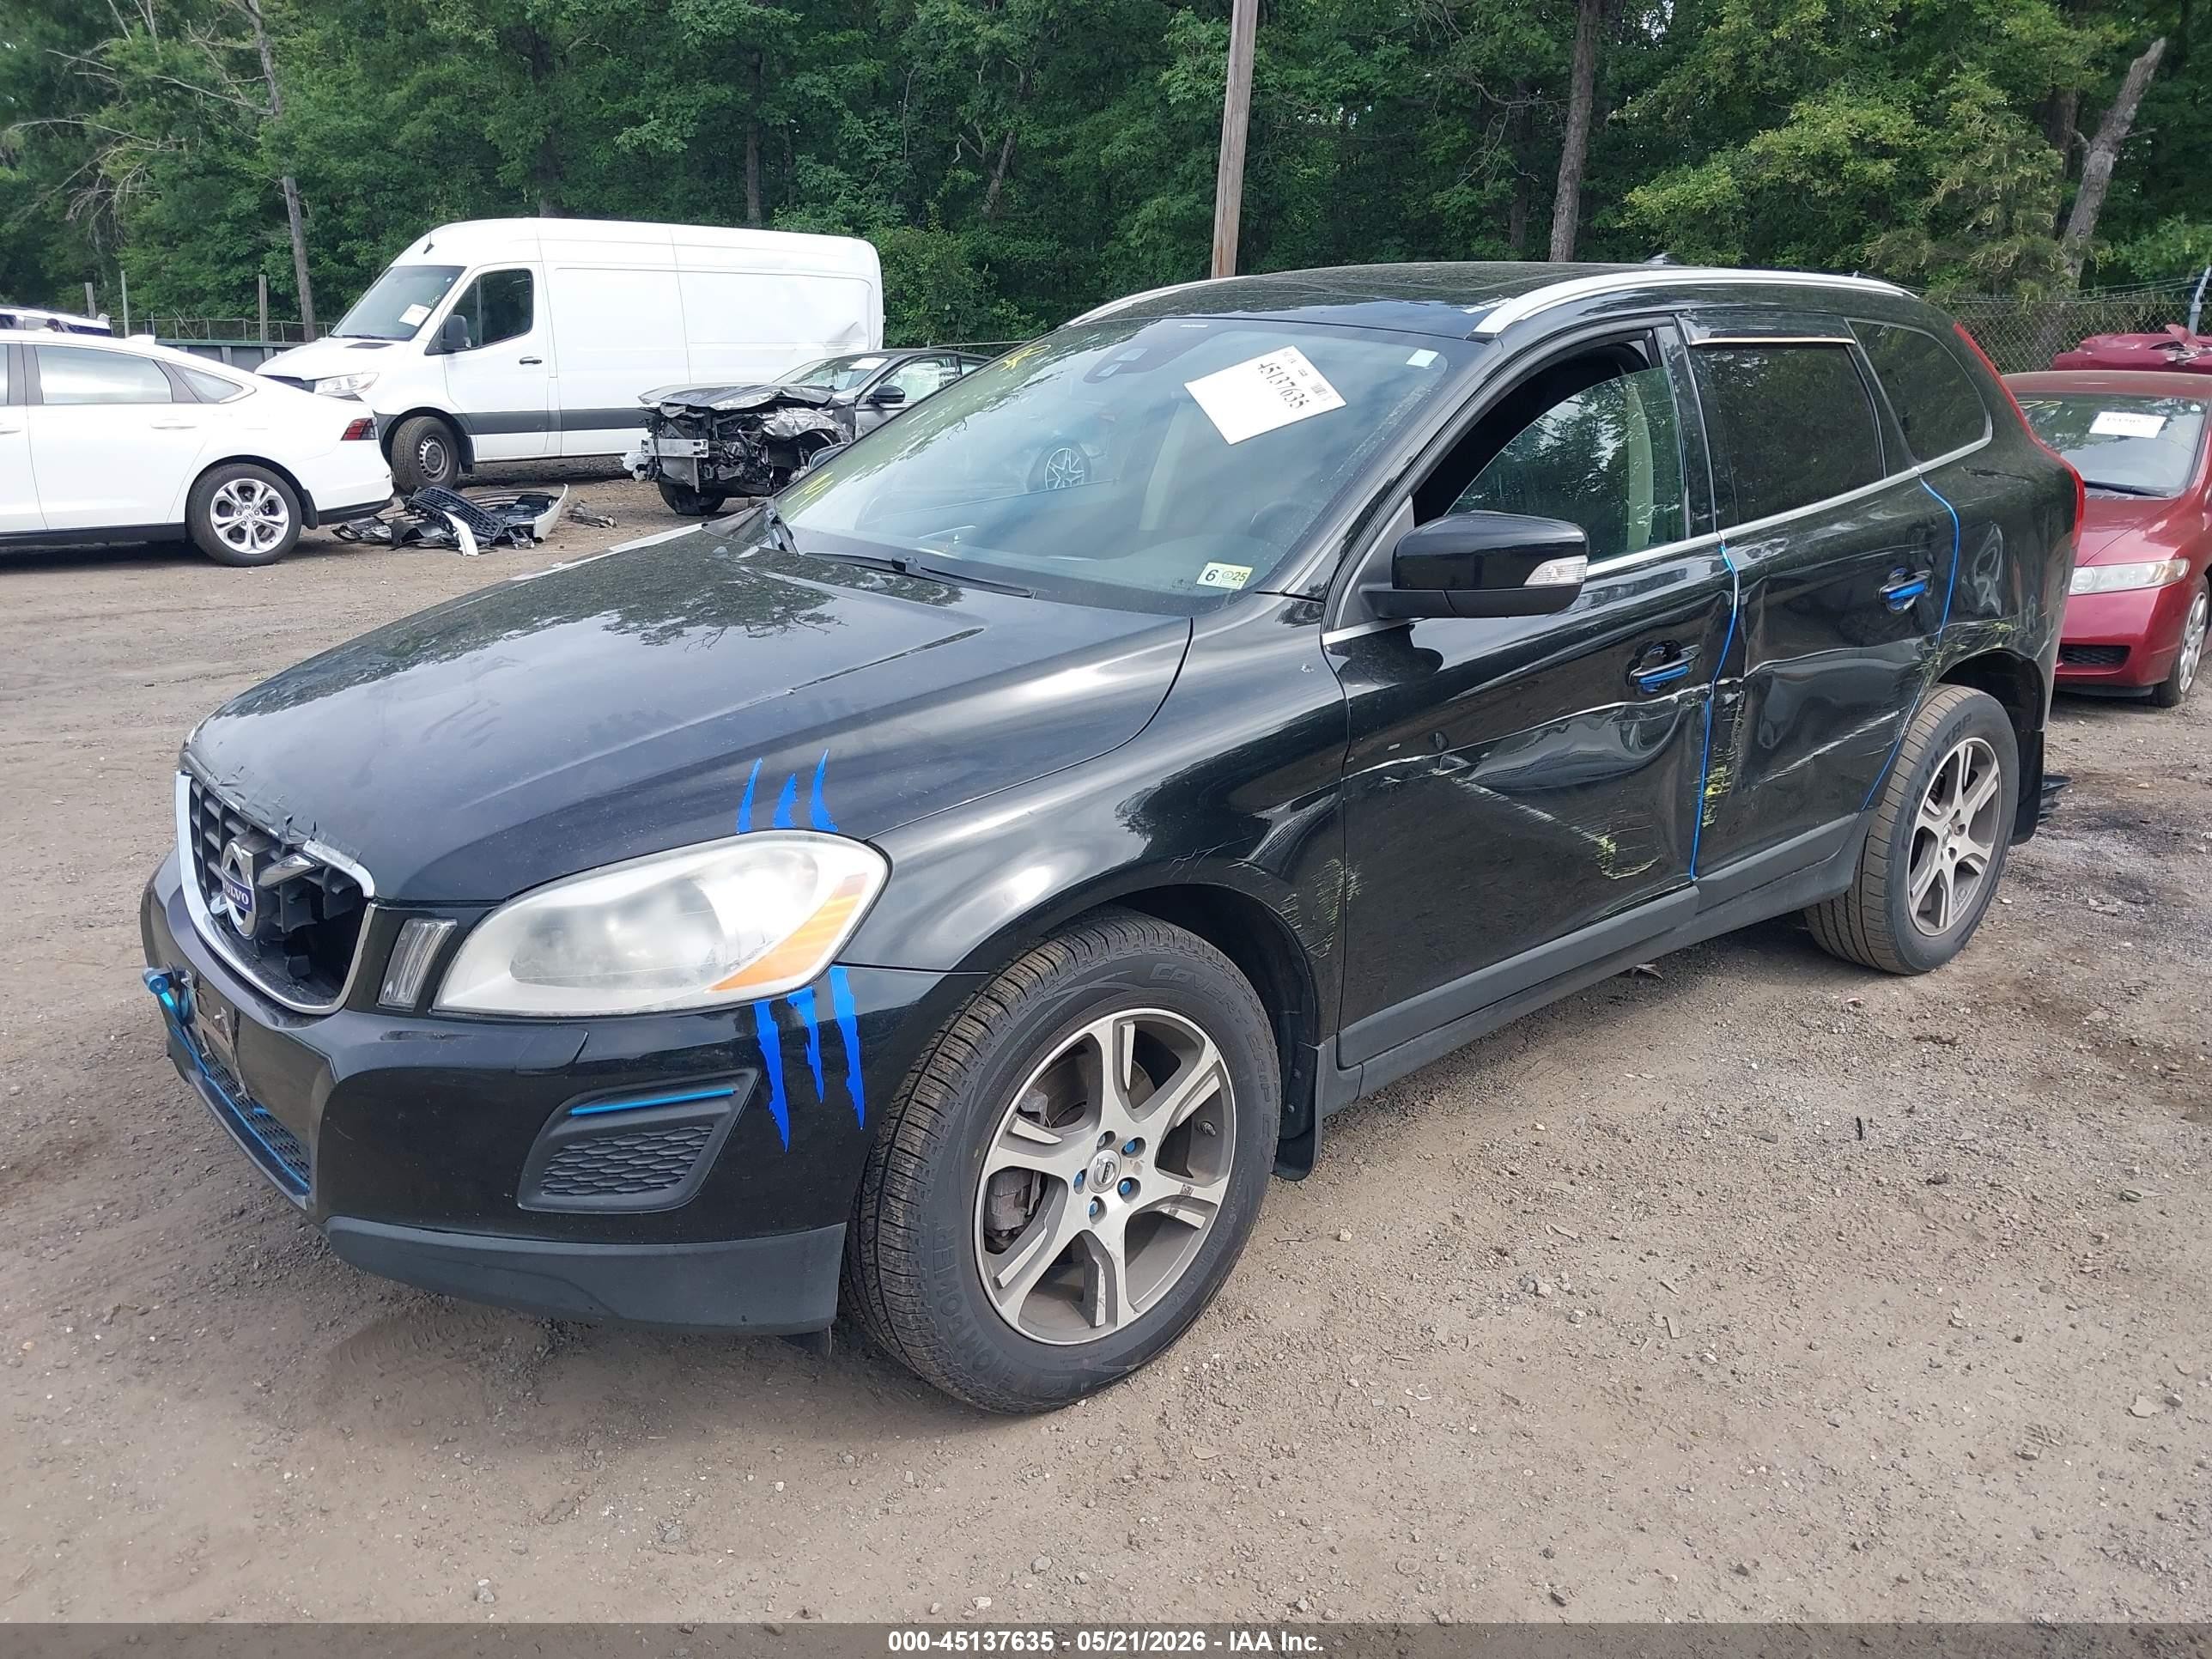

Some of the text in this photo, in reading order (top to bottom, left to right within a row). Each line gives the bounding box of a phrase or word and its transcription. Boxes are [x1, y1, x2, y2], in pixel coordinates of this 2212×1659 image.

[1257, 362, 1310, 410] 45137635
[1206, 569, 1248, 581] 6 25
